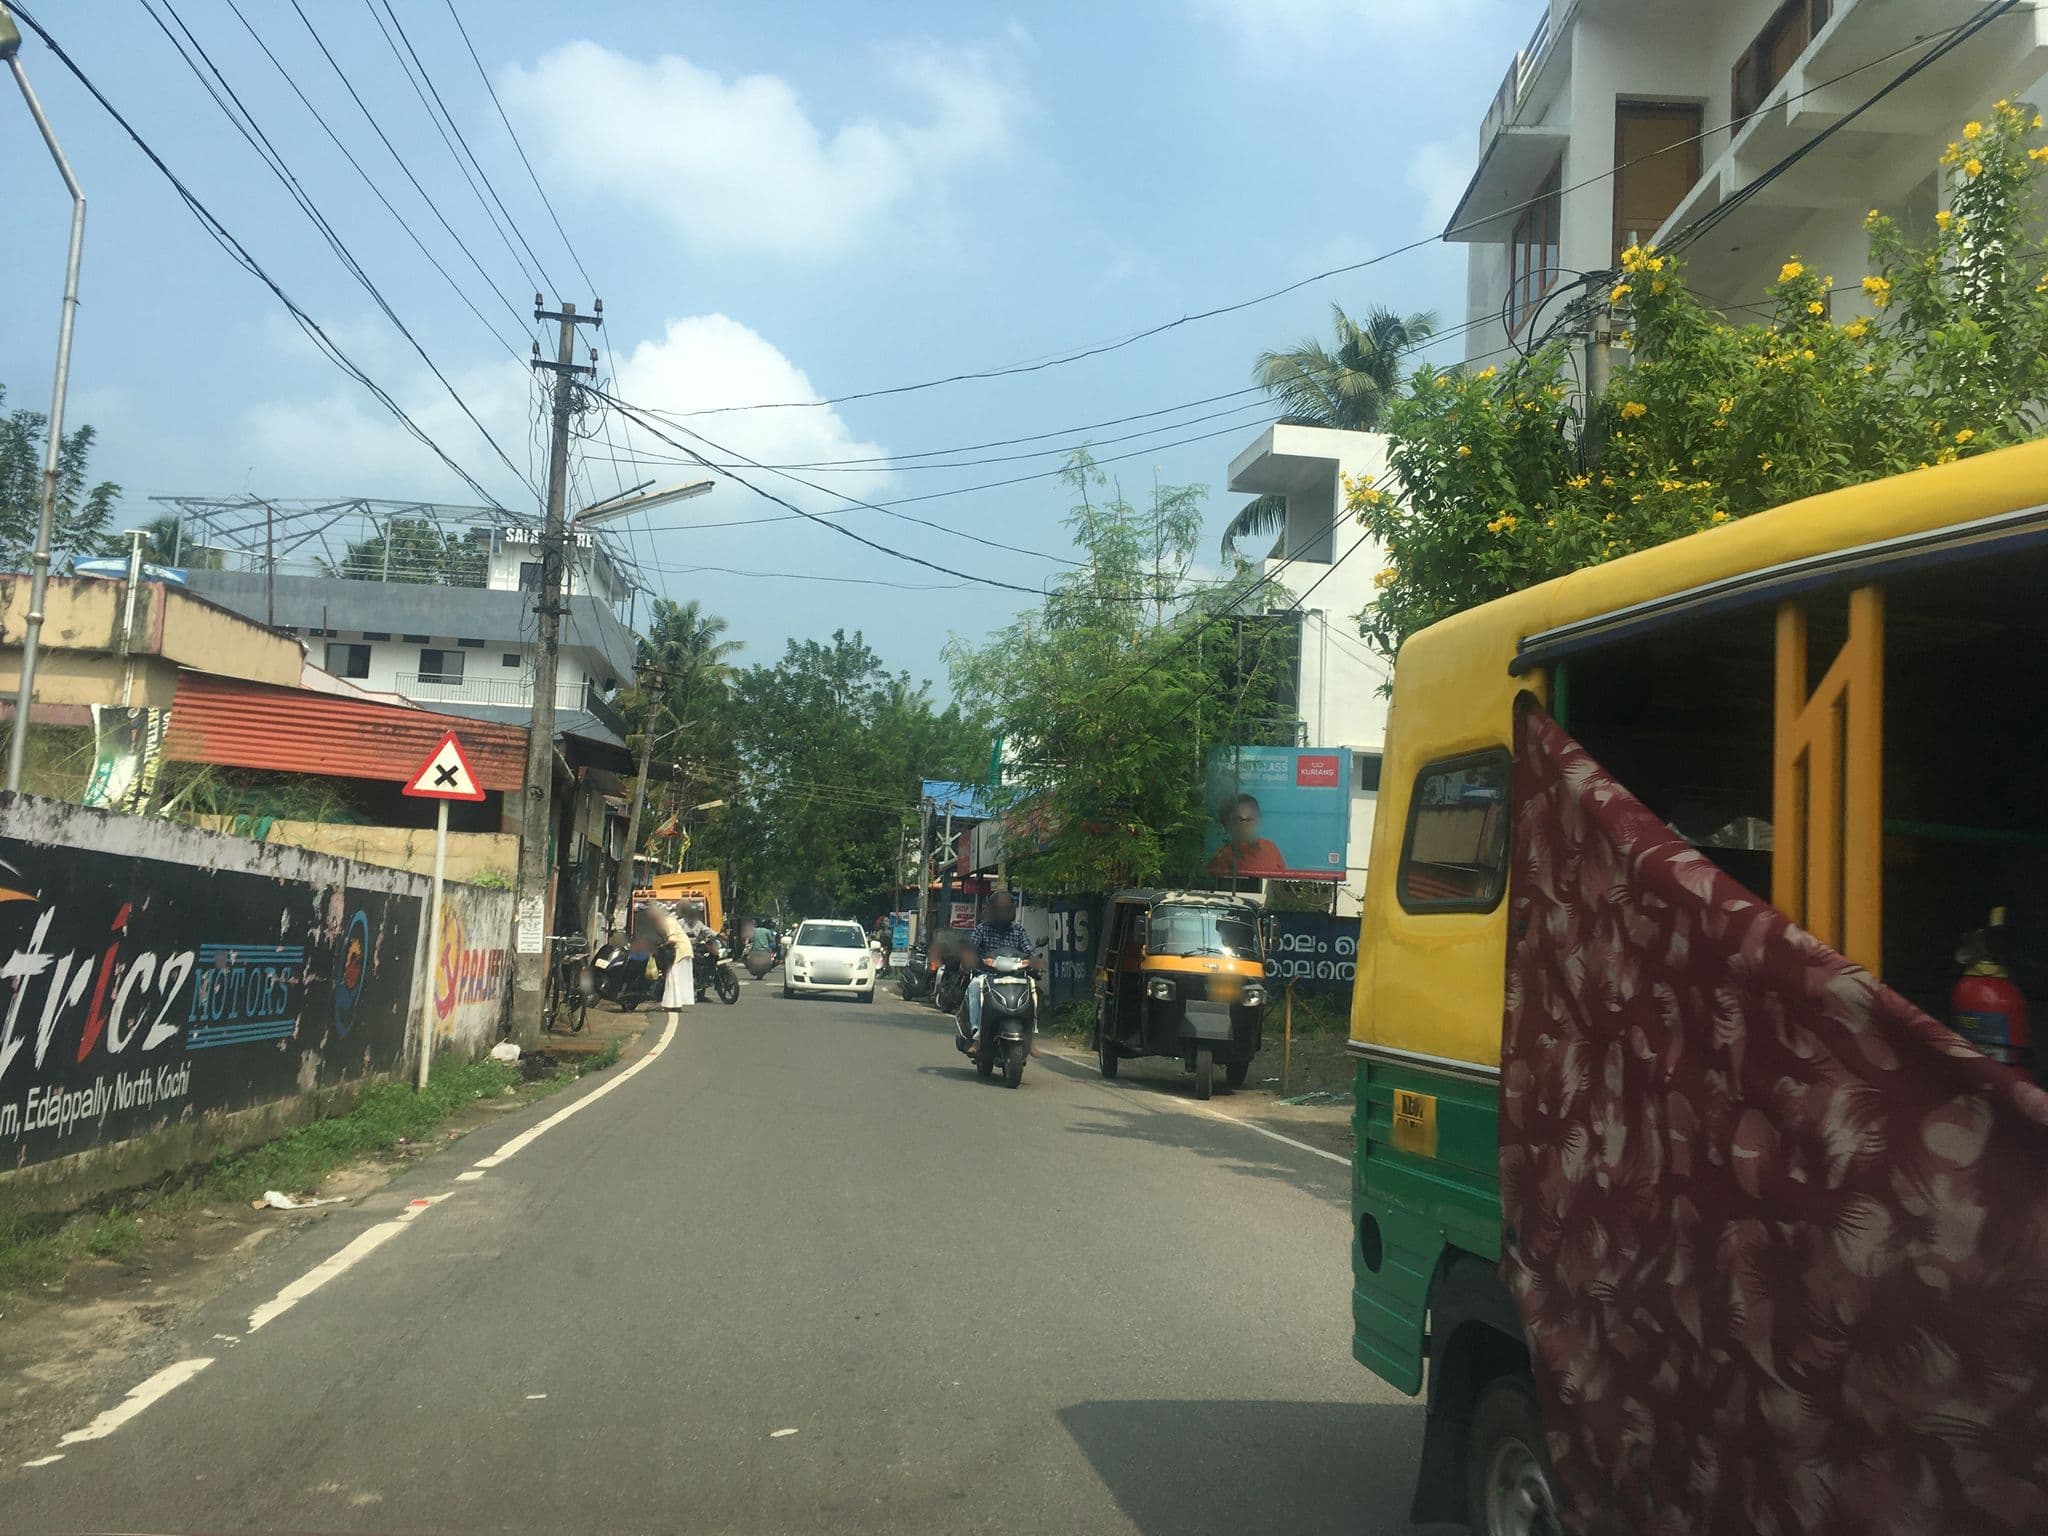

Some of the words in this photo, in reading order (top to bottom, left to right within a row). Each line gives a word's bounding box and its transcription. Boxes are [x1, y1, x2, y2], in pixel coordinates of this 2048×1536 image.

[1300, 768, 1335, 777] KURIANS
[188, 967, 292, 1023] MOTORS
[23, 1075, 112, 1139] Edappally
[113, 1067, 153, 1111] North,
[154, 1060, 192, 1103] Kochi
